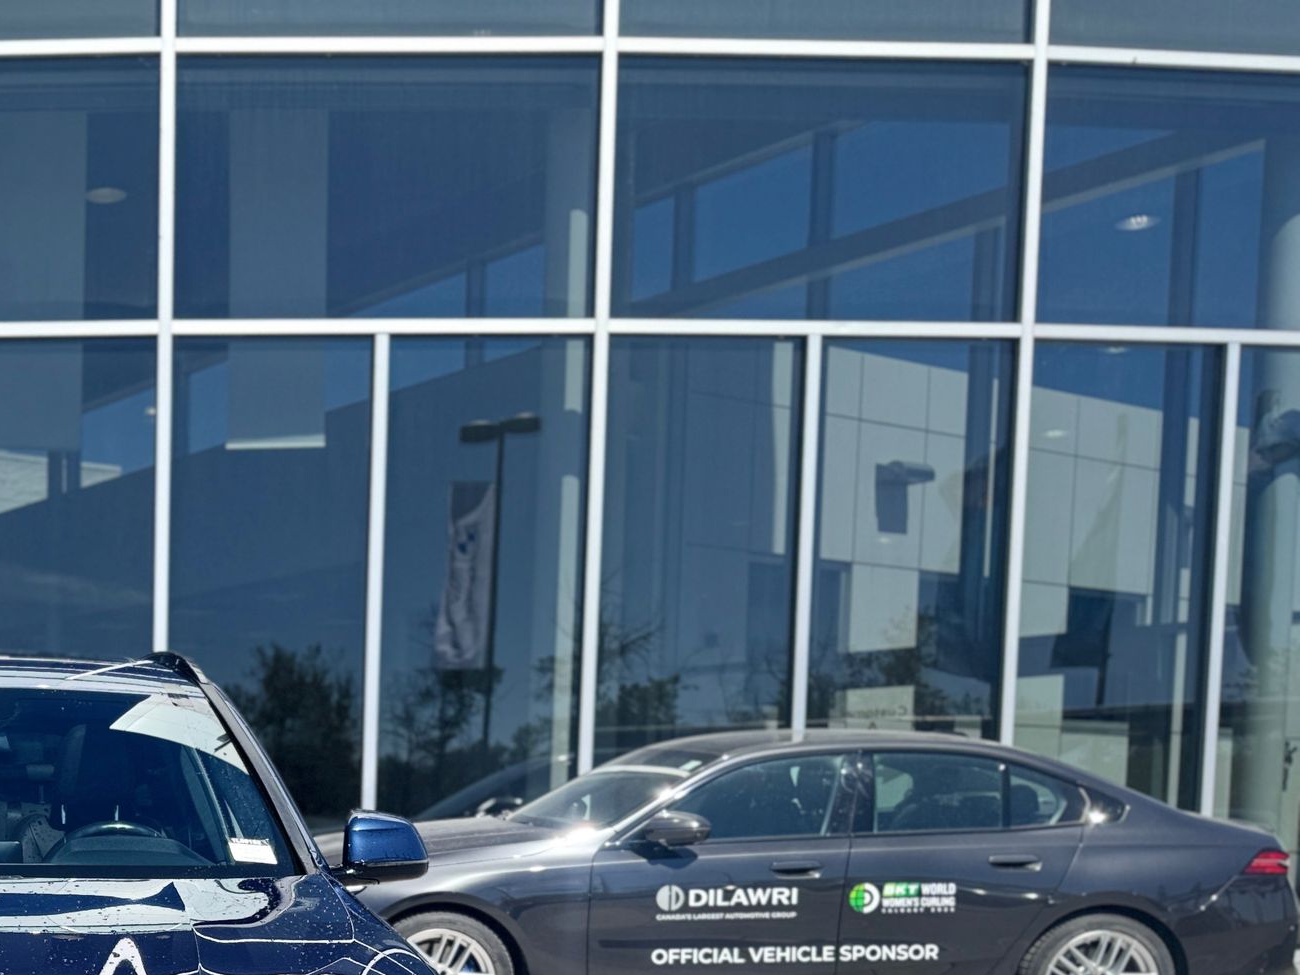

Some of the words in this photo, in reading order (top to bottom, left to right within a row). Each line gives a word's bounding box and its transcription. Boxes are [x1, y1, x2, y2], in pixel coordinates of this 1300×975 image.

[921, 882, 957, 896] WORLD
[688, 887, 798, 907] DILAWRI
[882, 896, 920, 907] WOMEN'S
[921, 896, 956, 907] CURLING
[656, 913, 692, 921] CANADA'S
[693, 913, 724, 921] LARGEST
[725, 912, 770, 920] AUTOMOTIVE
[771, 911, 797, 919] GROUP
[651, 948, 746, 966] OFFICIAL
[749, 946, 836, 963] VEHICLE
[839, 944, 939, 962] SPONSOR
